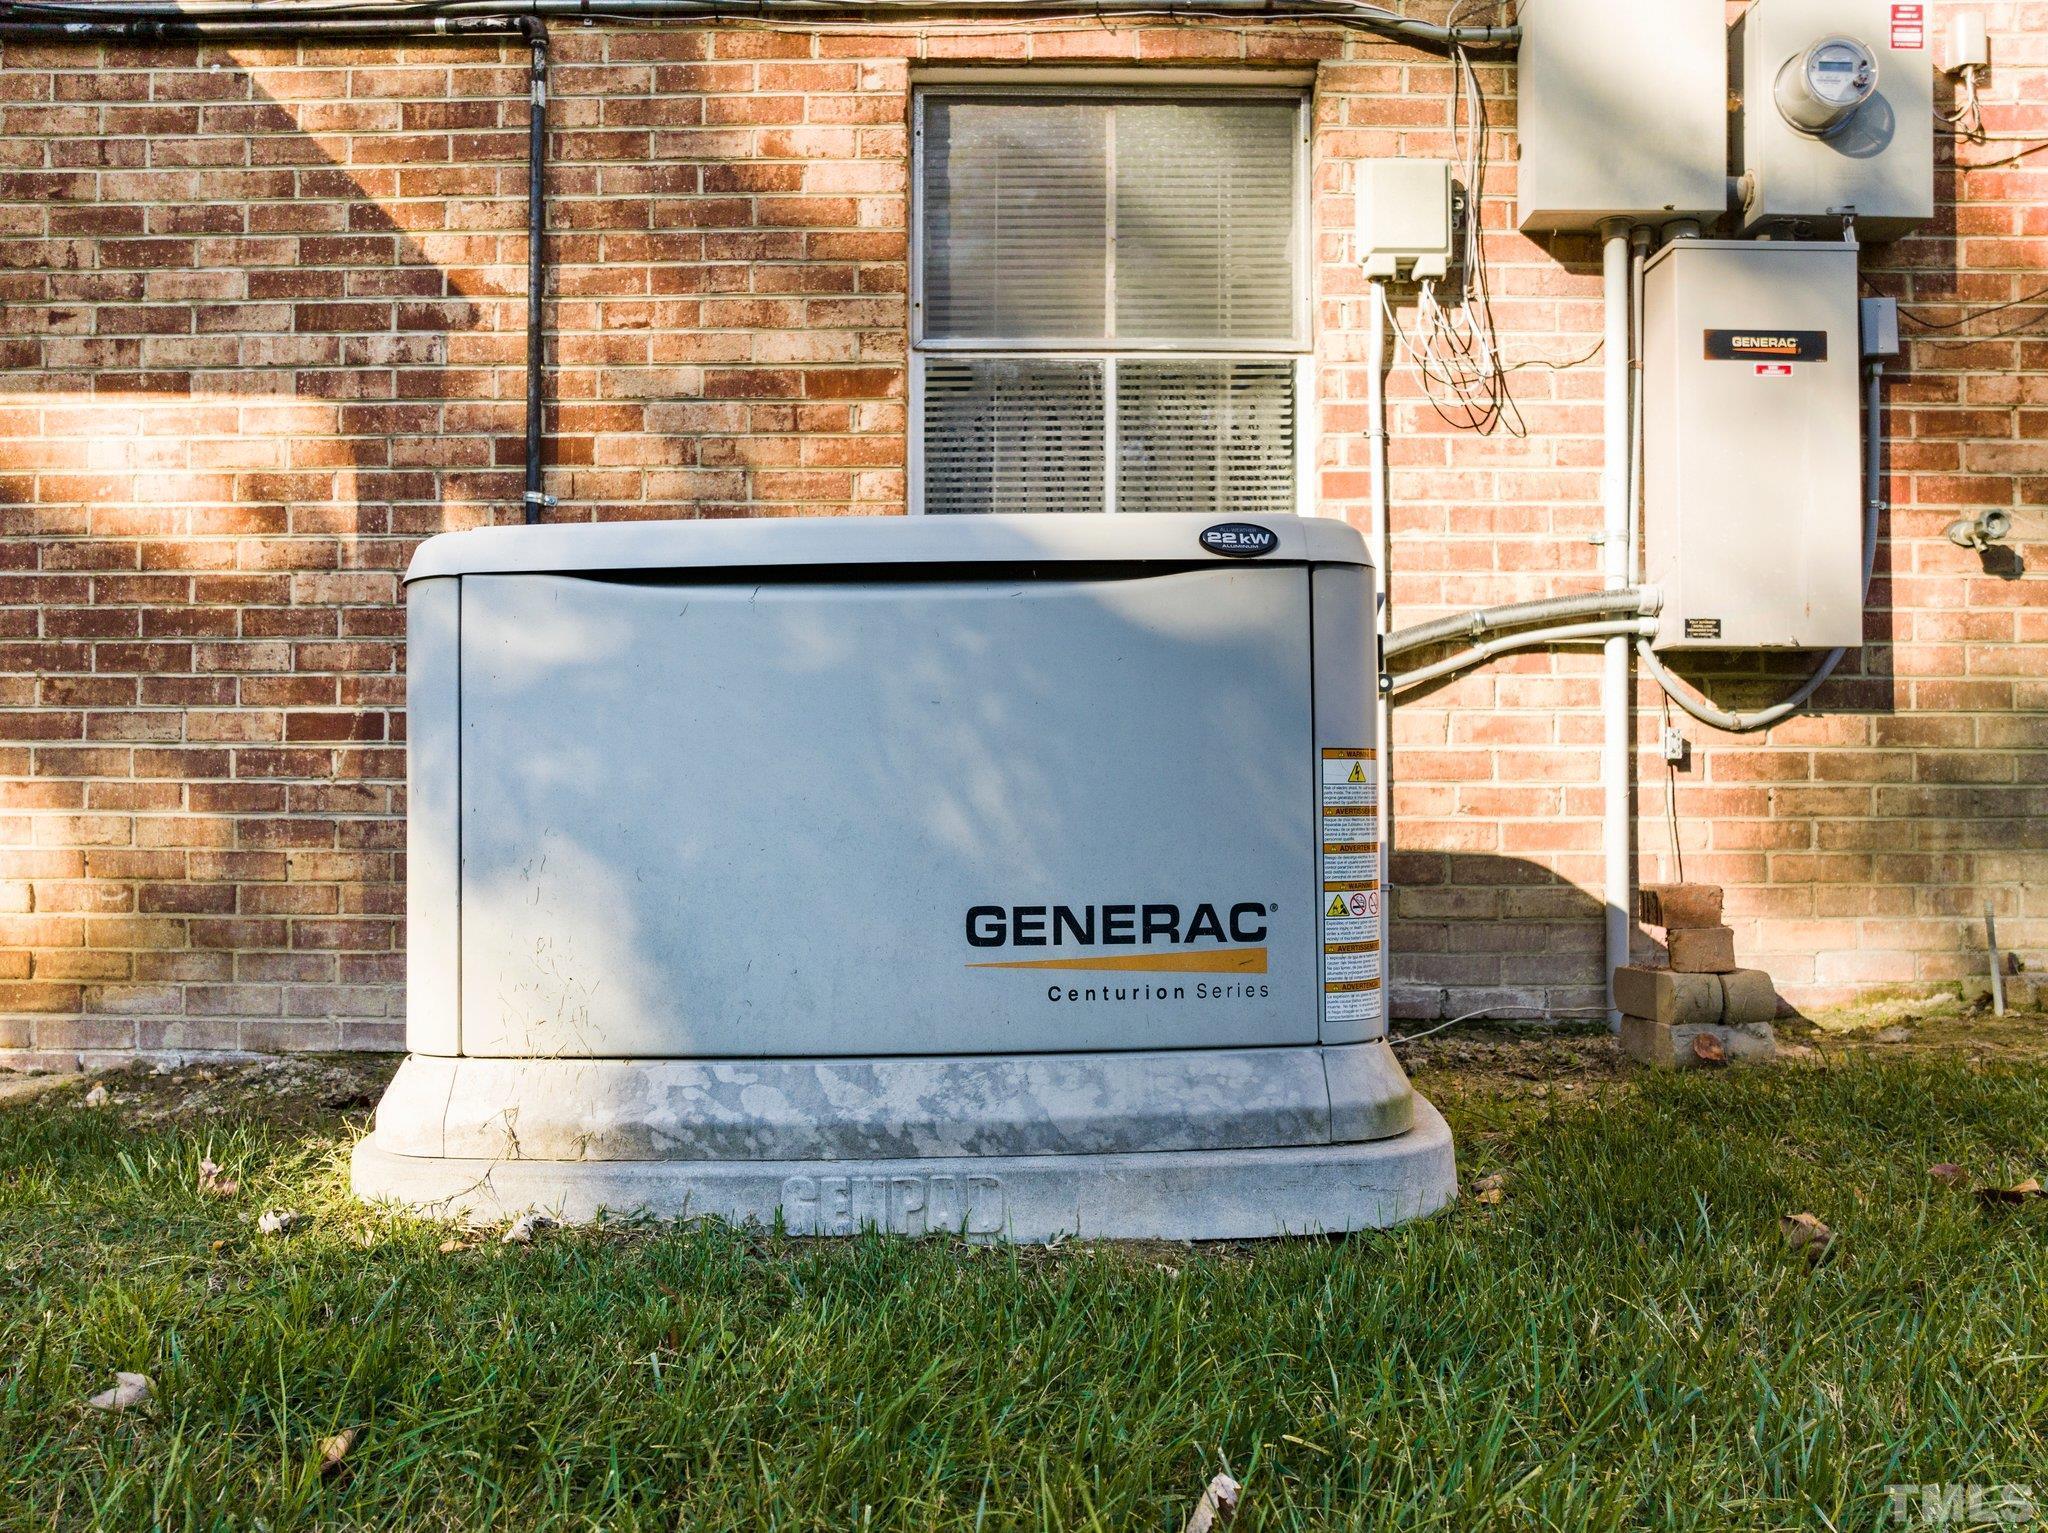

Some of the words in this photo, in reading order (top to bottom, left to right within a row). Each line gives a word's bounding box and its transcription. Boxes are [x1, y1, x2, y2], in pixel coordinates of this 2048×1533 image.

[1731, 336, 1797, 348] GENERAC
[1207, 532, 1238, 544] 22
[1240, 533, 1270, 545] kW
[965, 902, 1268, 947] GENERAC
[1047, 984, 1185, 1002] Centurion
[1196, 982, 1269, 999] Series
